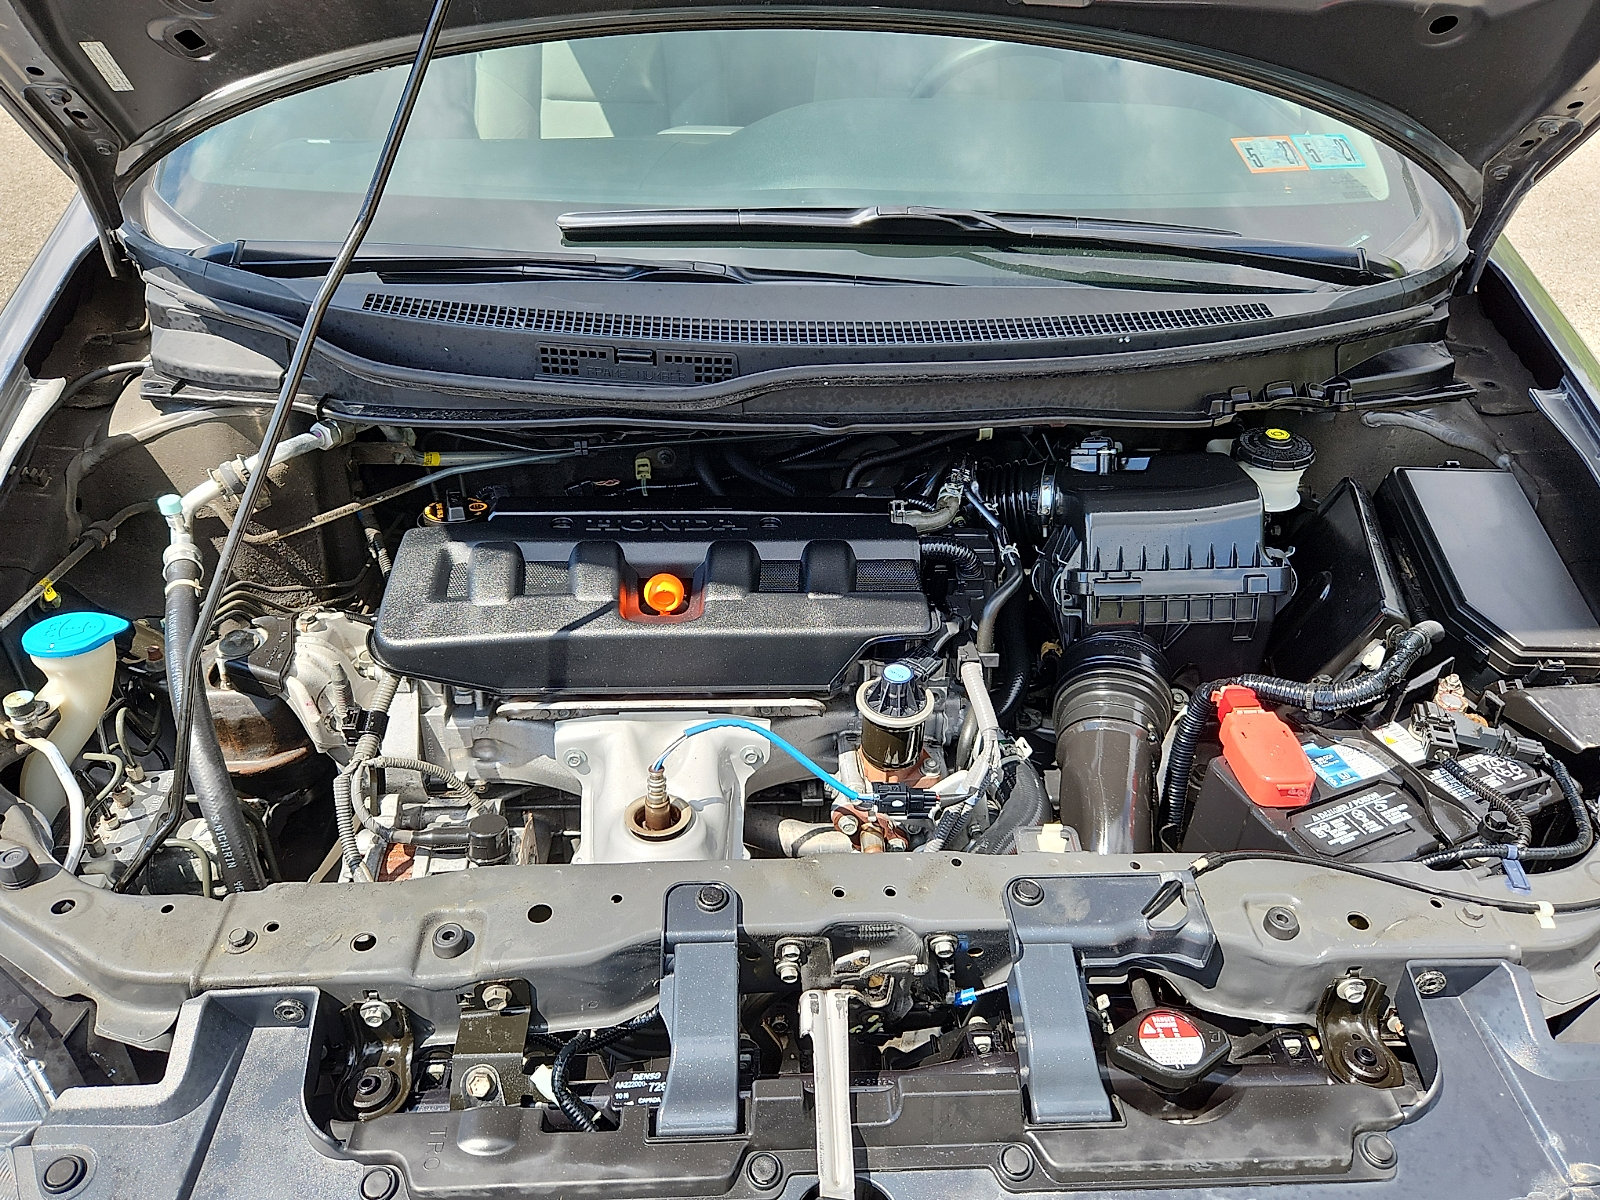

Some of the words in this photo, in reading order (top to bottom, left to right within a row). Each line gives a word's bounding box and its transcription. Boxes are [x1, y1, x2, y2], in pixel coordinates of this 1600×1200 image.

[1245, 147, 1264, 168] 5
[1303, 143, 1322, 163] 5
[586, 366, 627, 379] FRAME
[636, 370, 687, 383] NUMBER
[585, 519, 748, 531] HONDA
[632, 1072, 662, 1081] DENSO
[423, 1126, 447, 1172] TPO
